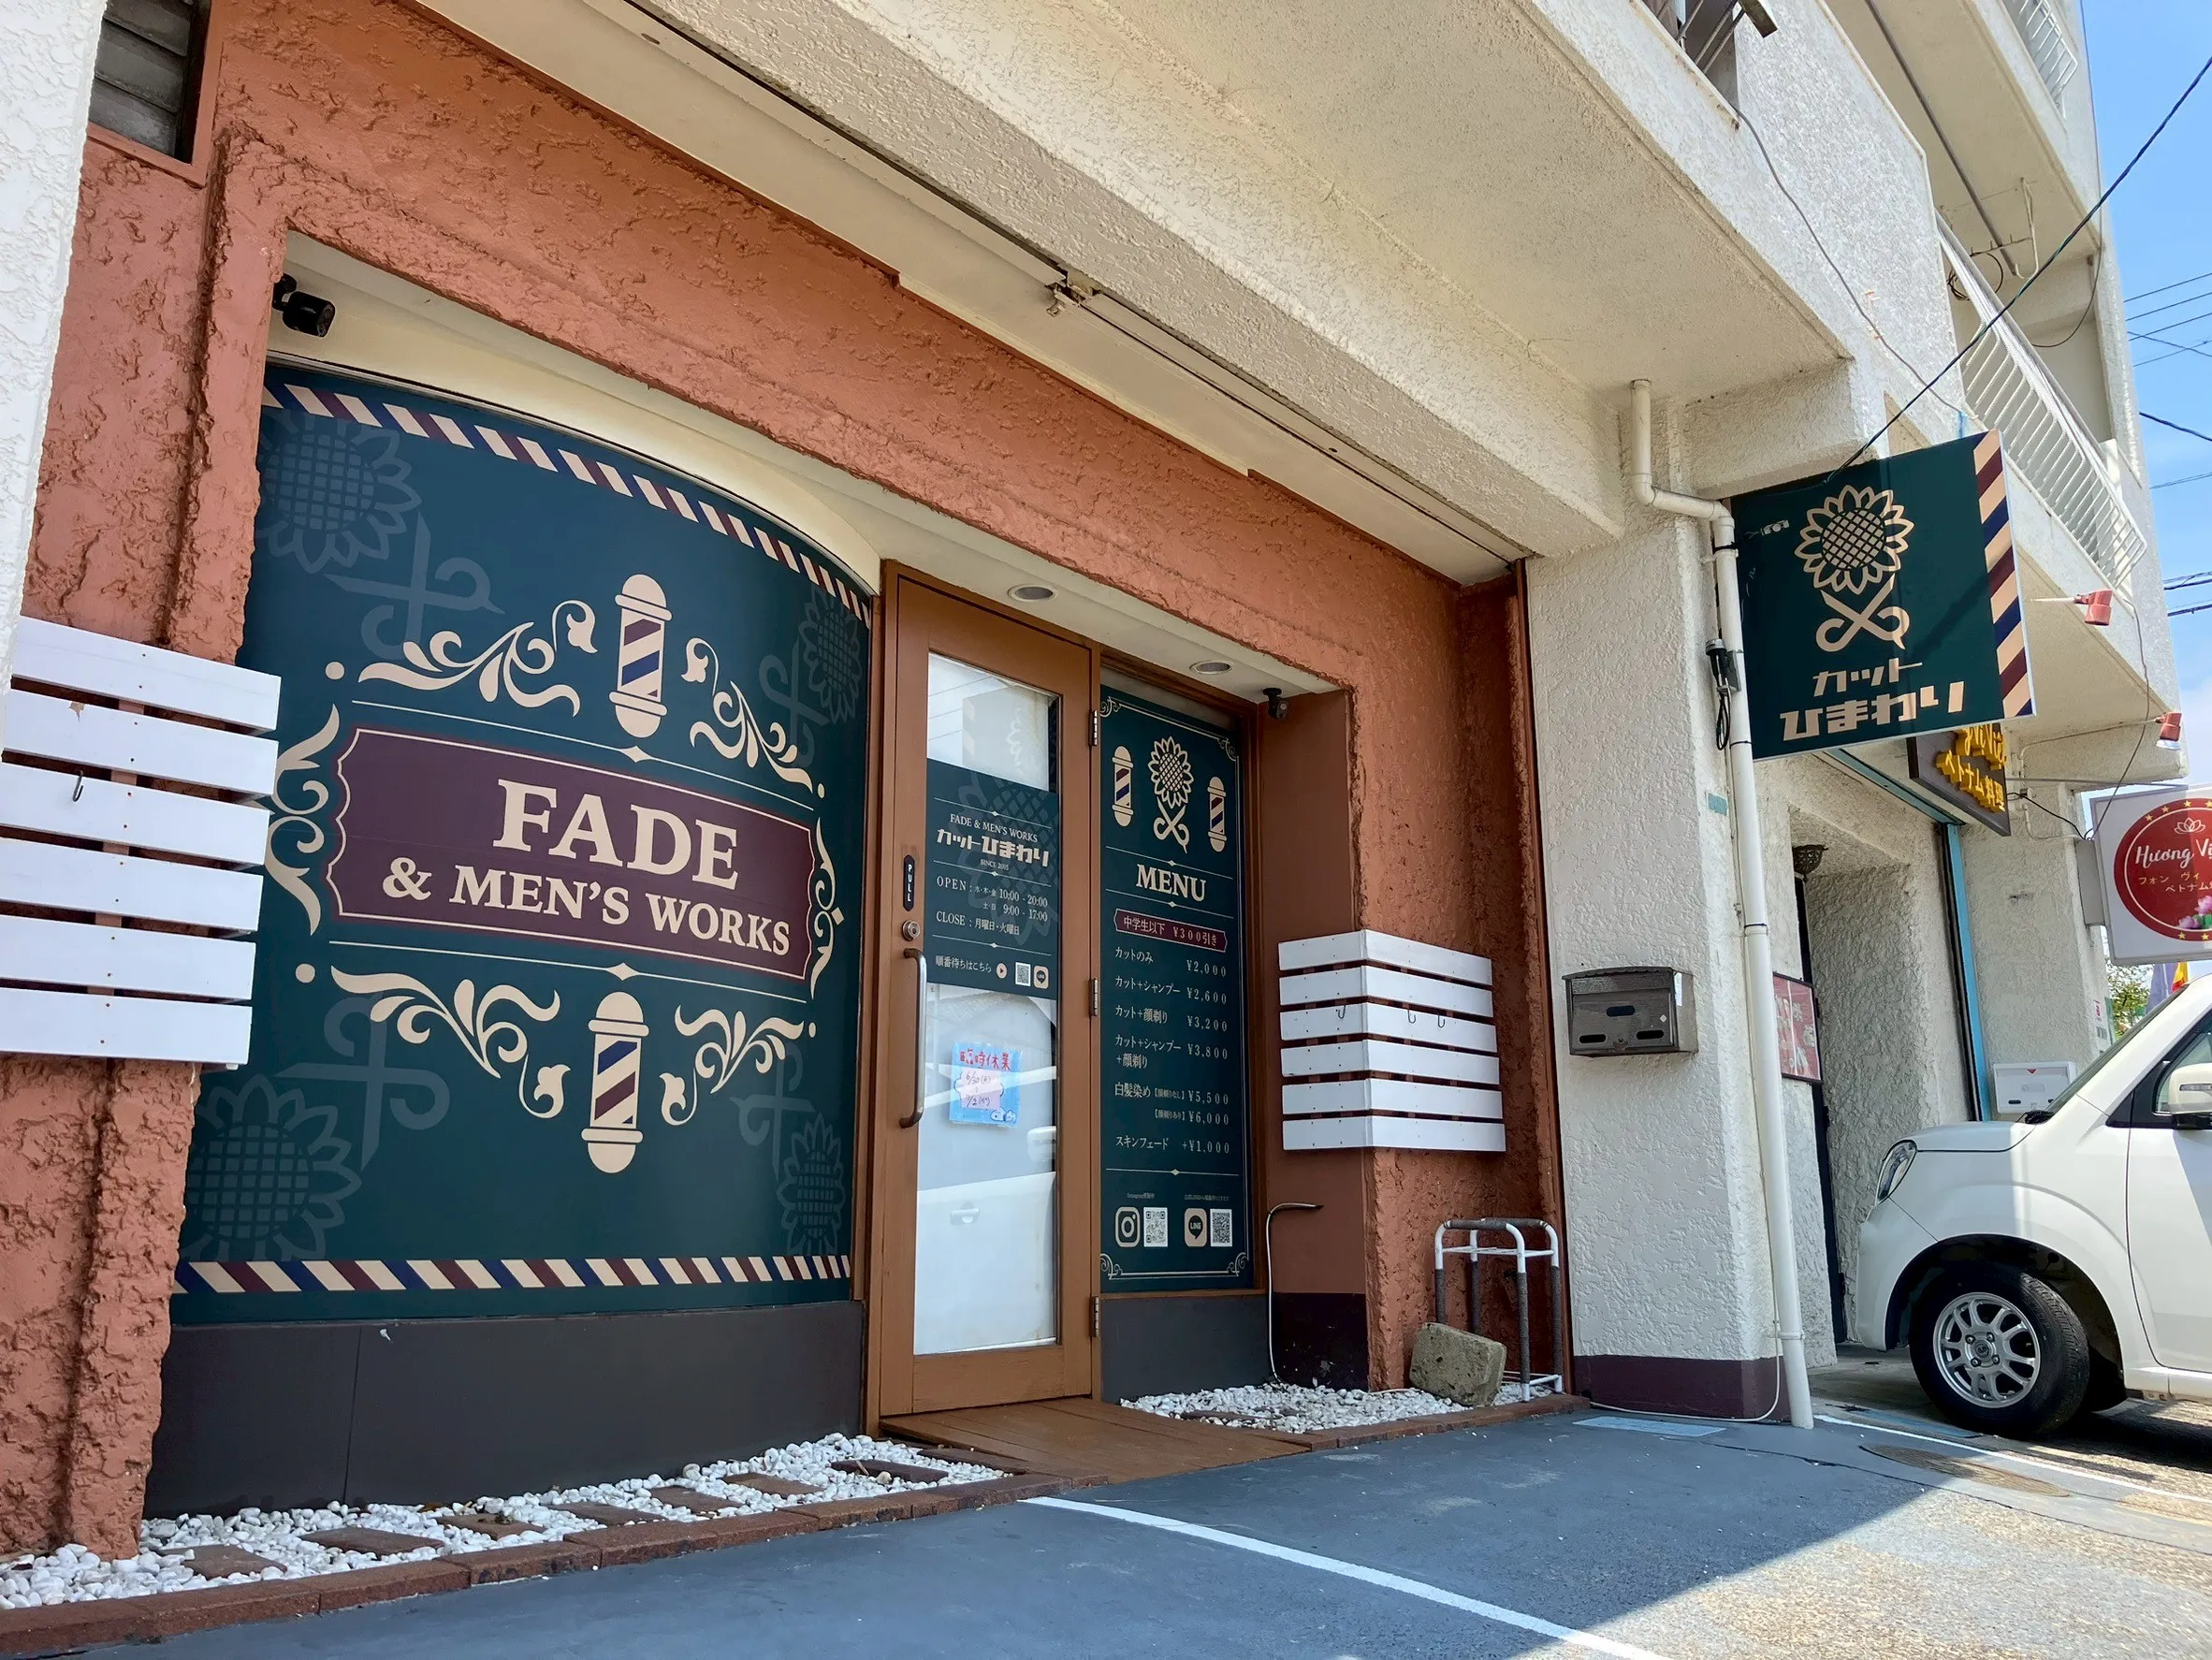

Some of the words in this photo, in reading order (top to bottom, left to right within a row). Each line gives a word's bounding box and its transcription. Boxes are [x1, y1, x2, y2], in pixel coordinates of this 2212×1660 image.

[1812, 658, 1923, 697] カット
[1780, 681, 1965, 741] ひまわり
[492, 779, 738, 891] FADE
[950, 813, 972, 827] FADE
[974, 819, 981, 829] &
[982, 822, 1008, 836] MEN'S
[1009, 827, 1038, 842] WORKS
[980, 858, 997, 868] SINCE
[937, 876, 967, 891] OPEN
[999, 888, 1020, 902] 10:00
[1027, 895, 1048, 908] 20:00
[1135, 864, 1207, 902] MENU
[383, 857, 432, 901] &
[449, 864, 630, 925] MEN'S
[646, 893, 790, 956] WORKS
[936, 911, 966, 925] CLOSE
[1003, 904, 1020, 916] 9:00
[1029, 910, 1048, 922] 17:00
[1124, 915, 1166, 935] 中学生以下
[1114, 946, 1154, 965] カットのみ
[1114, 1082, 1151, 1098] 白髪染め
[1115, 1135, 1169, 1150] スキンフェード
